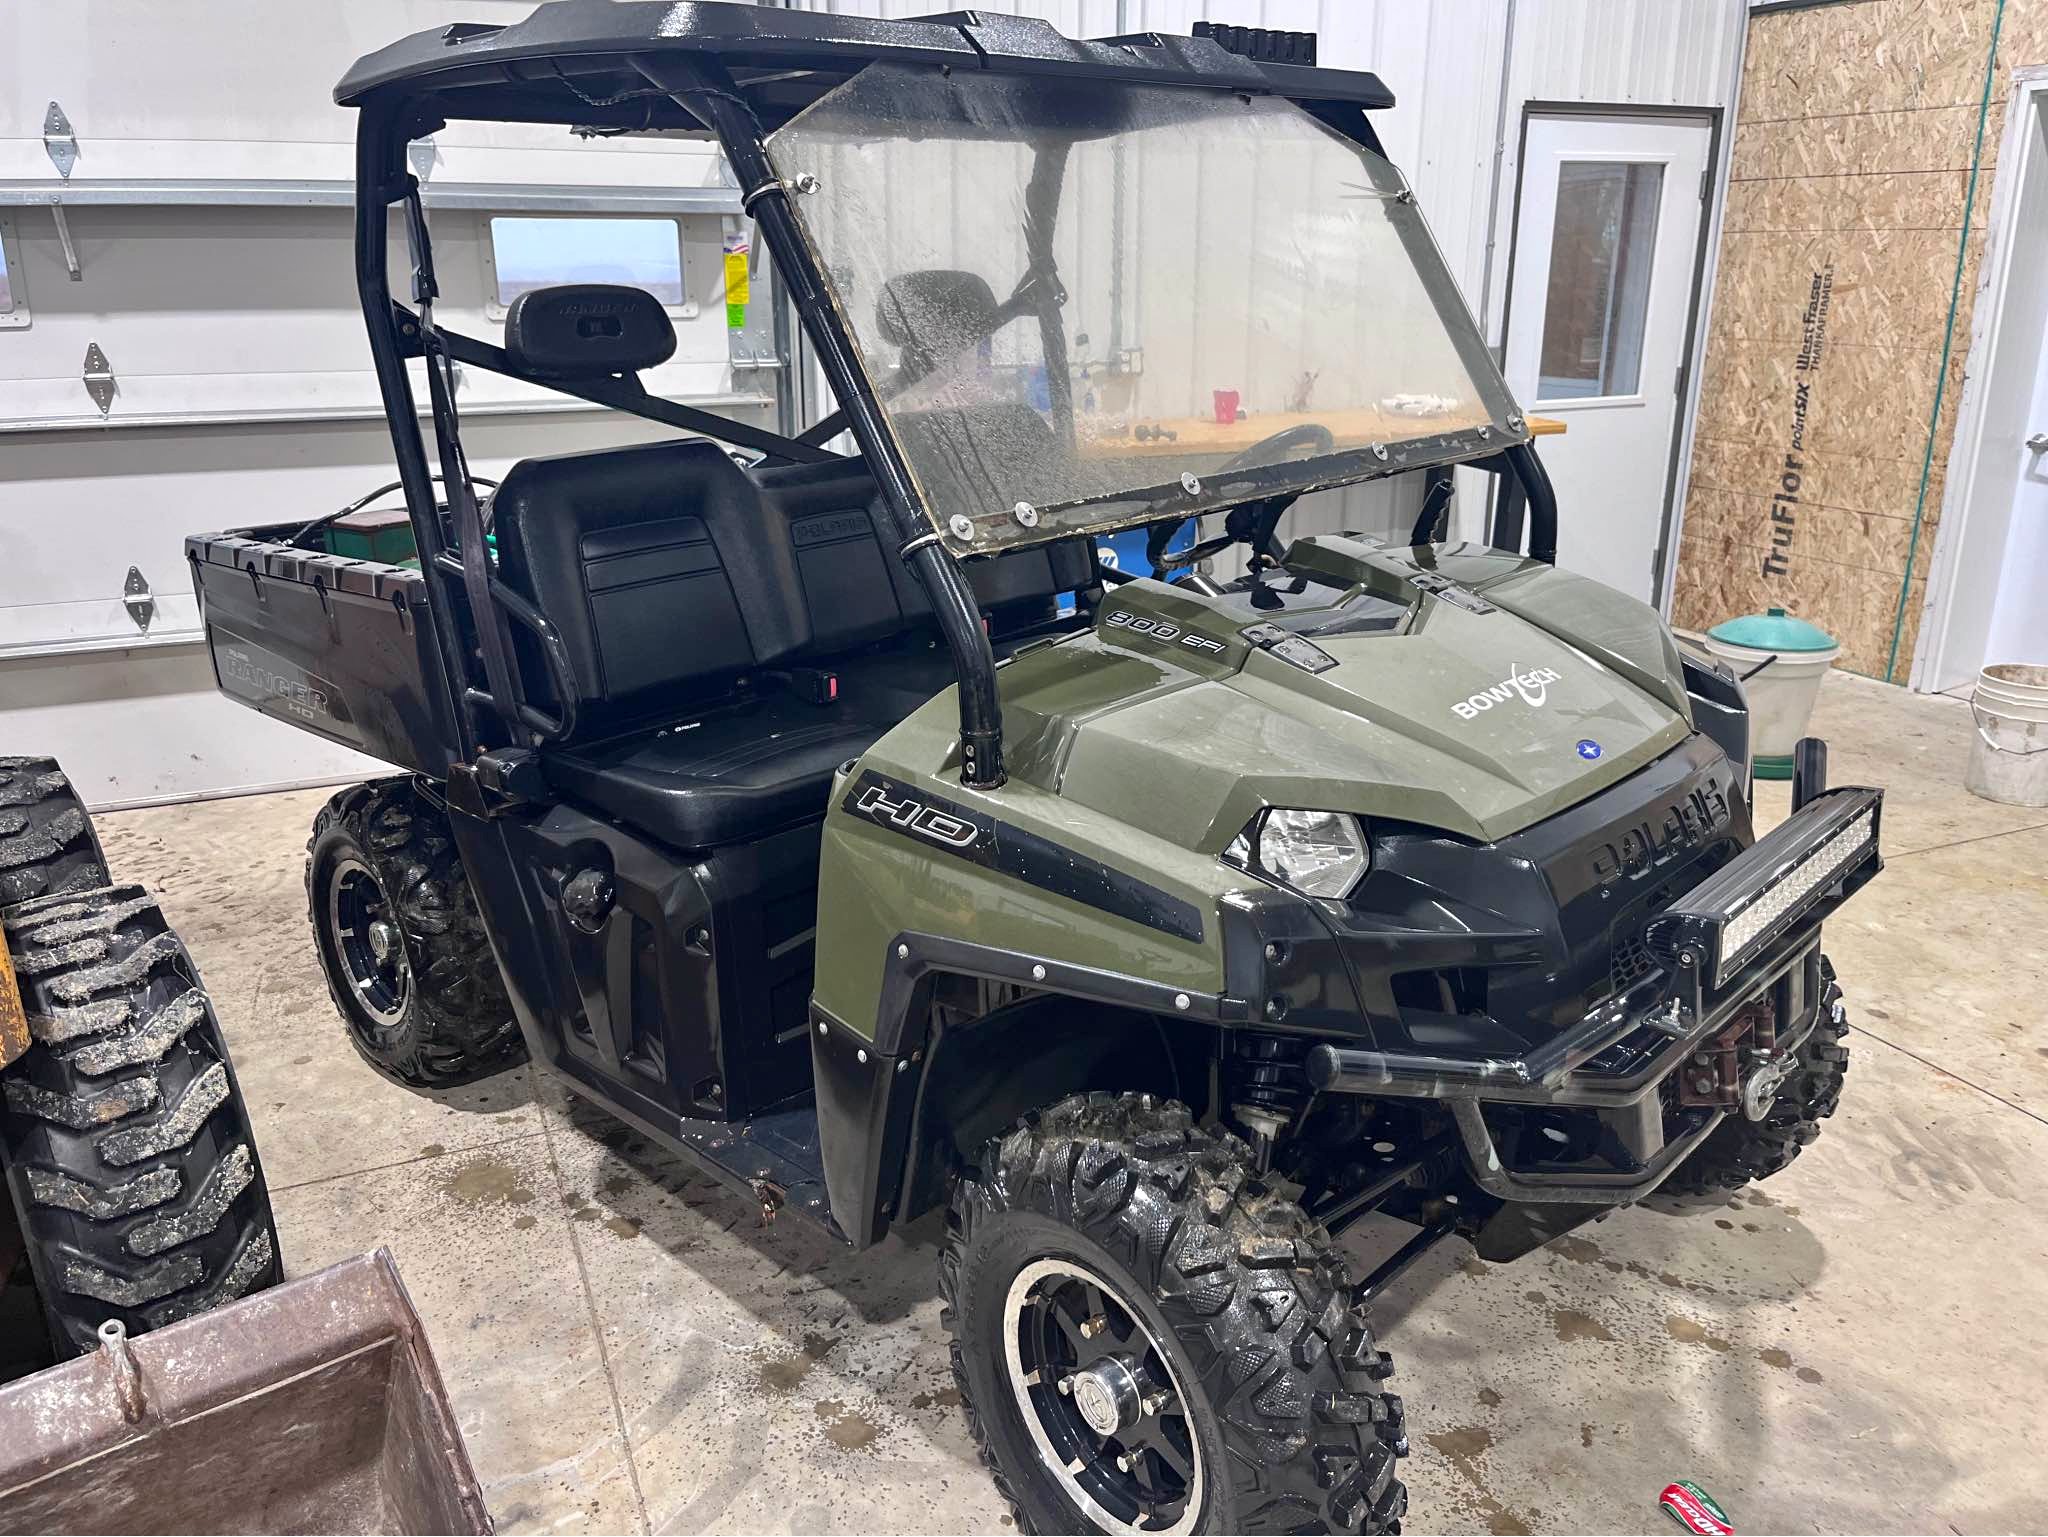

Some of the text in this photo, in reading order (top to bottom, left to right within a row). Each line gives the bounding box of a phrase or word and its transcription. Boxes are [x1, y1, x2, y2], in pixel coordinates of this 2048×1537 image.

[1796, 272, 1823, 371] West Fraser
[1761, 453, 1804, 578] TruFlor
[1106, 610, 1181, 642] 800
[1180, 633, 1225, 654] EFI
[225, 658, 328, 715] RANGER
[288, 703, 314, 719] HD
[1450, 662, 1562, 720] BOWTECH
[857, 786, 979, 847] HD
[1590, 777, 1730, 889] POLARIS
